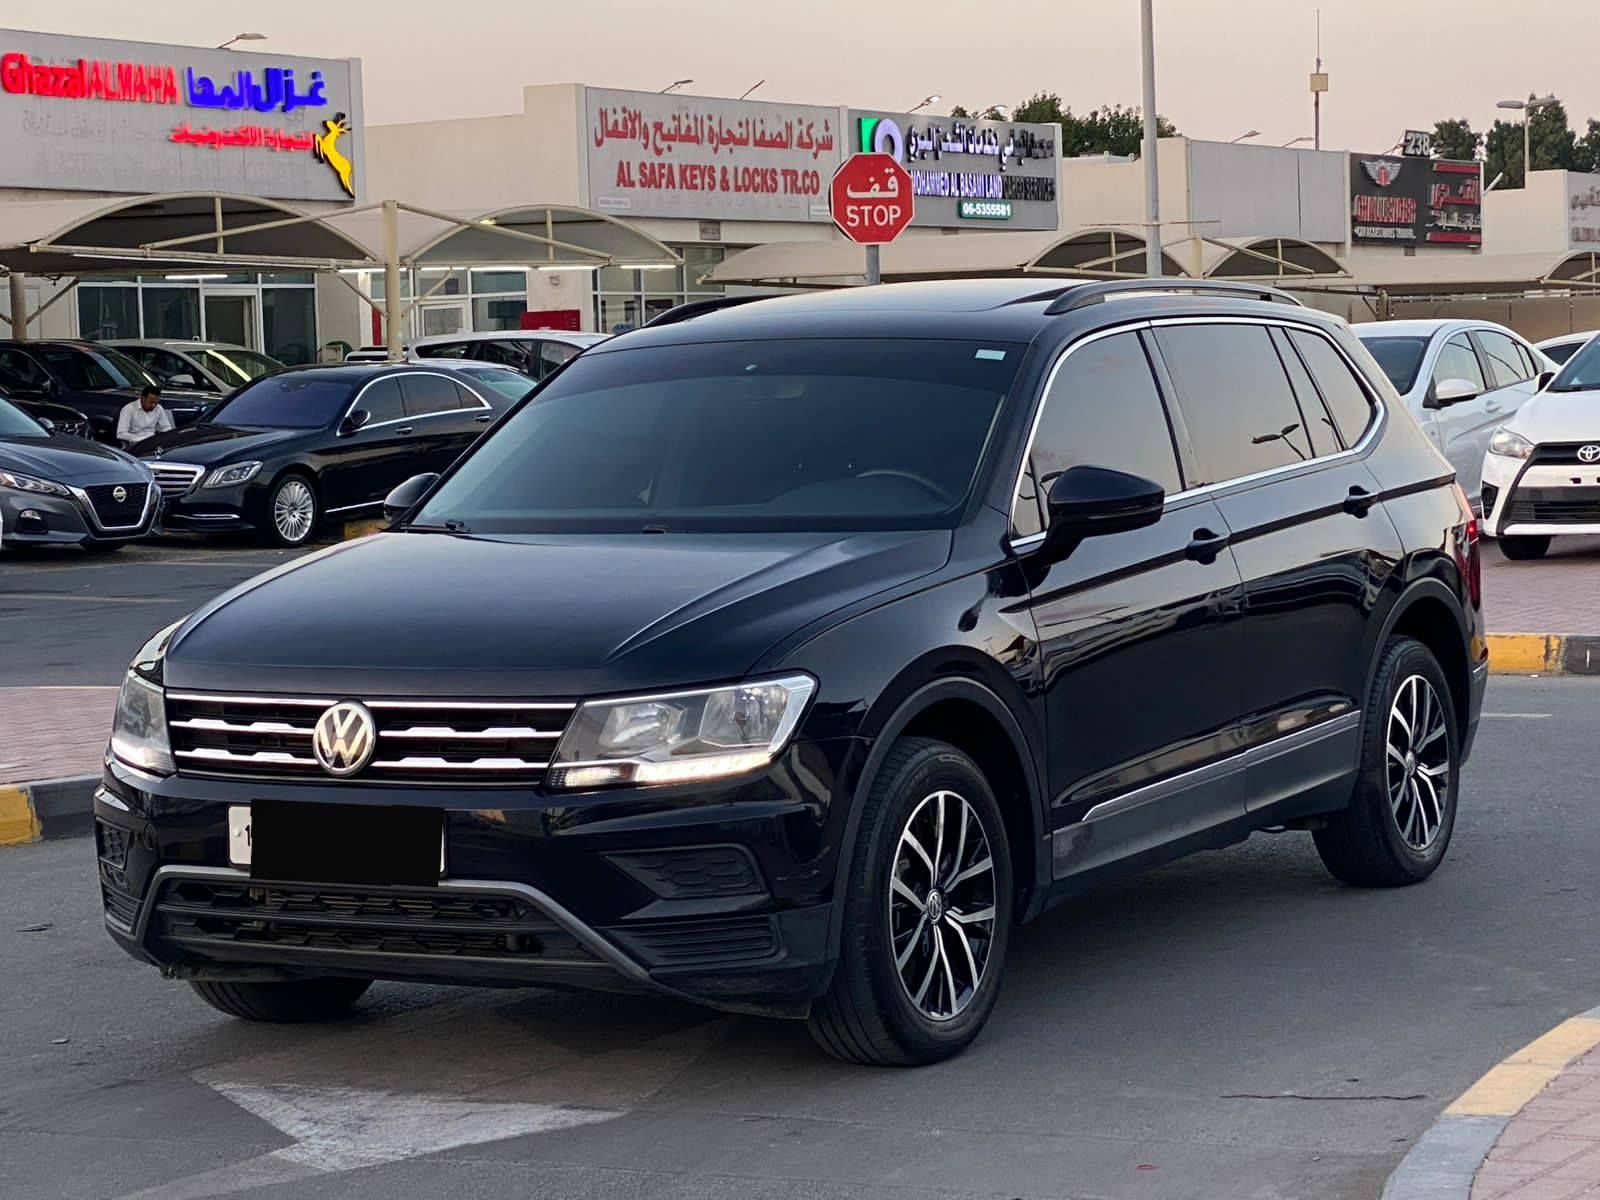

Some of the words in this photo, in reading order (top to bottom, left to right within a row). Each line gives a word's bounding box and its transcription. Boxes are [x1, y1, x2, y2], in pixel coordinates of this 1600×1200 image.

[1, 52, 88, 99] Ghazal
[88, 59, 181, 105] ALMAHA
[187, 66, 252, 110] المها
[253, 67, 327, 112] غزال
[652, 112, 705, 156] المفاتيح
[707, 113, 750, 154] لتجارة
[752, 118, 793, 149] الصفا
[796, 118, 833, 160] شركة
[1404, 132, 1430, 156] 238
[616, 159, 635, 188] AL
[639, 161, 676, 190] SAFA
[679, 163, 716, 192] KEYS
[720, 165, 730, 192] &
[734, 166, 778, 194] LOCKS
[847, 167, 899, 199] قف
[846, 204, 902, 227] STOP
